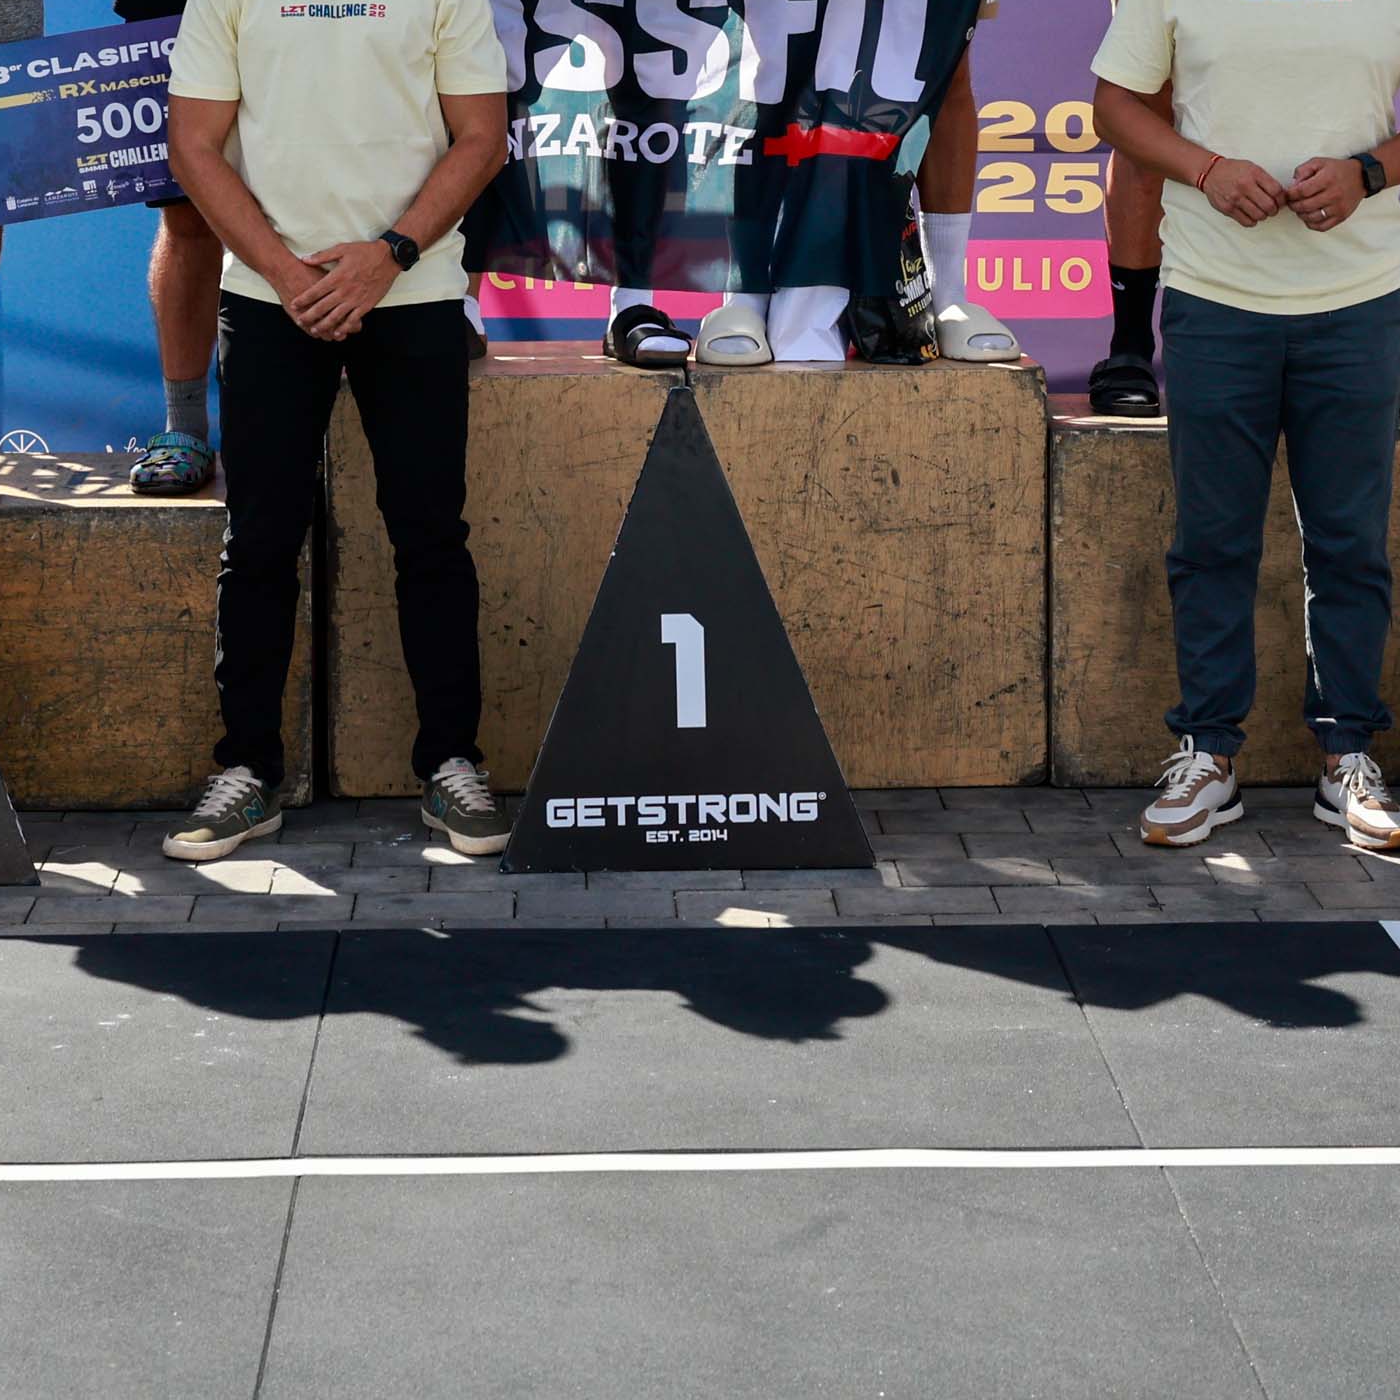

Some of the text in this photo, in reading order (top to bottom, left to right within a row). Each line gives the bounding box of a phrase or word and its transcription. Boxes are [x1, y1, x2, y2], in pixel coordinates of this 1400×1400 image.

[281, 3, 386, 19] LZT CHALLENGE 20
[27, 37, 177, 78] CLASIFIC
[59, 73, 169, 99] RX MASCUL
[76, 97, 168, 144] 500
[978, 100, 1102, 152] 20
[76, 142, 168, 168] LZT CHALLEN
[78, 163, 108, 174] SMMR
[978, 161, 1103, 214] 25
[964, 257, 1092, 291] ULIO
[660, 613, 707, 728] 1
[545, 791, 819, 828] GETSTRONG
[645, 829, 728, 843] EST. 2014
